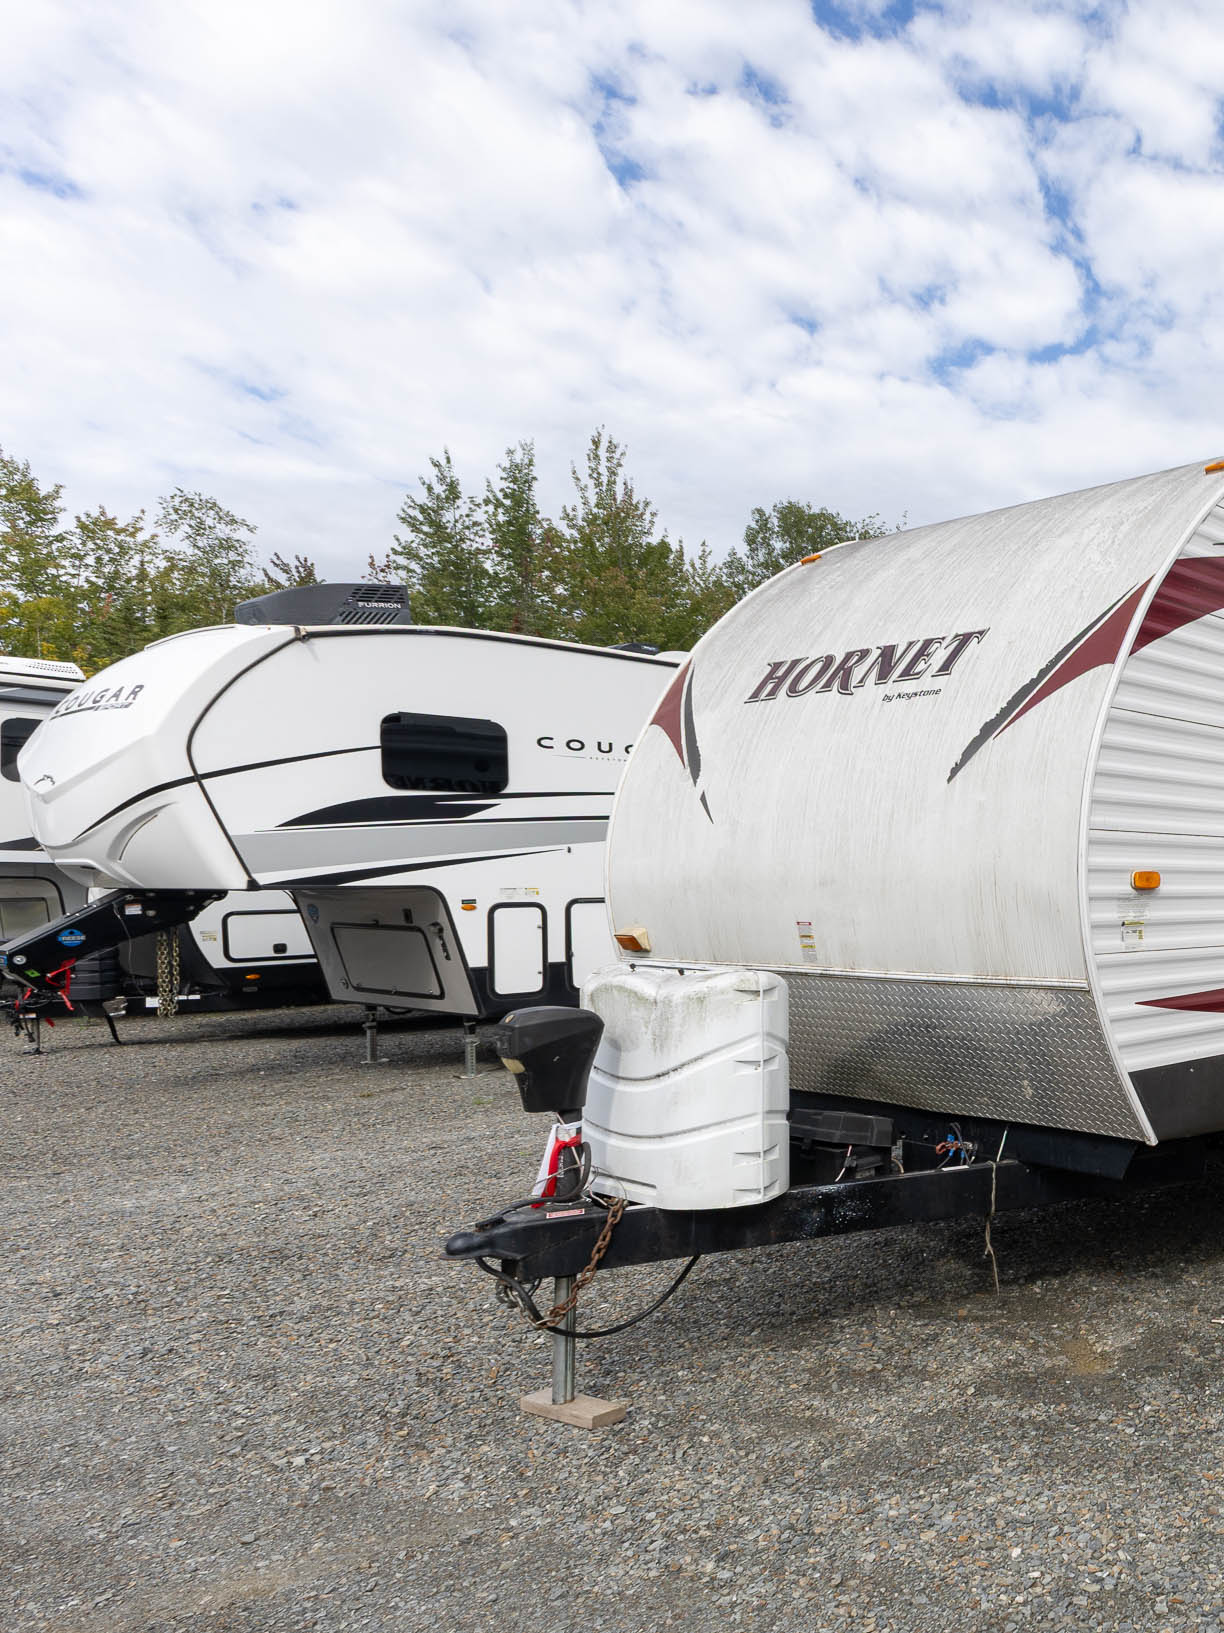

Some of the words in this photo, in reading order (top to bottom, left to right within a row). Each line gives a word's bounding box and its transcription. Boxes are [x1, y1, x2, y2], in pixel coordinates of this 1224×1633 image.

[357, 601, 402, 609] FURRION
[743, 627, 991, 704] HORNET
[54, 684, 145, 715] COUGAR
[881, 694, 896, 702] by
[896, 688, 942, 701] Keystone
